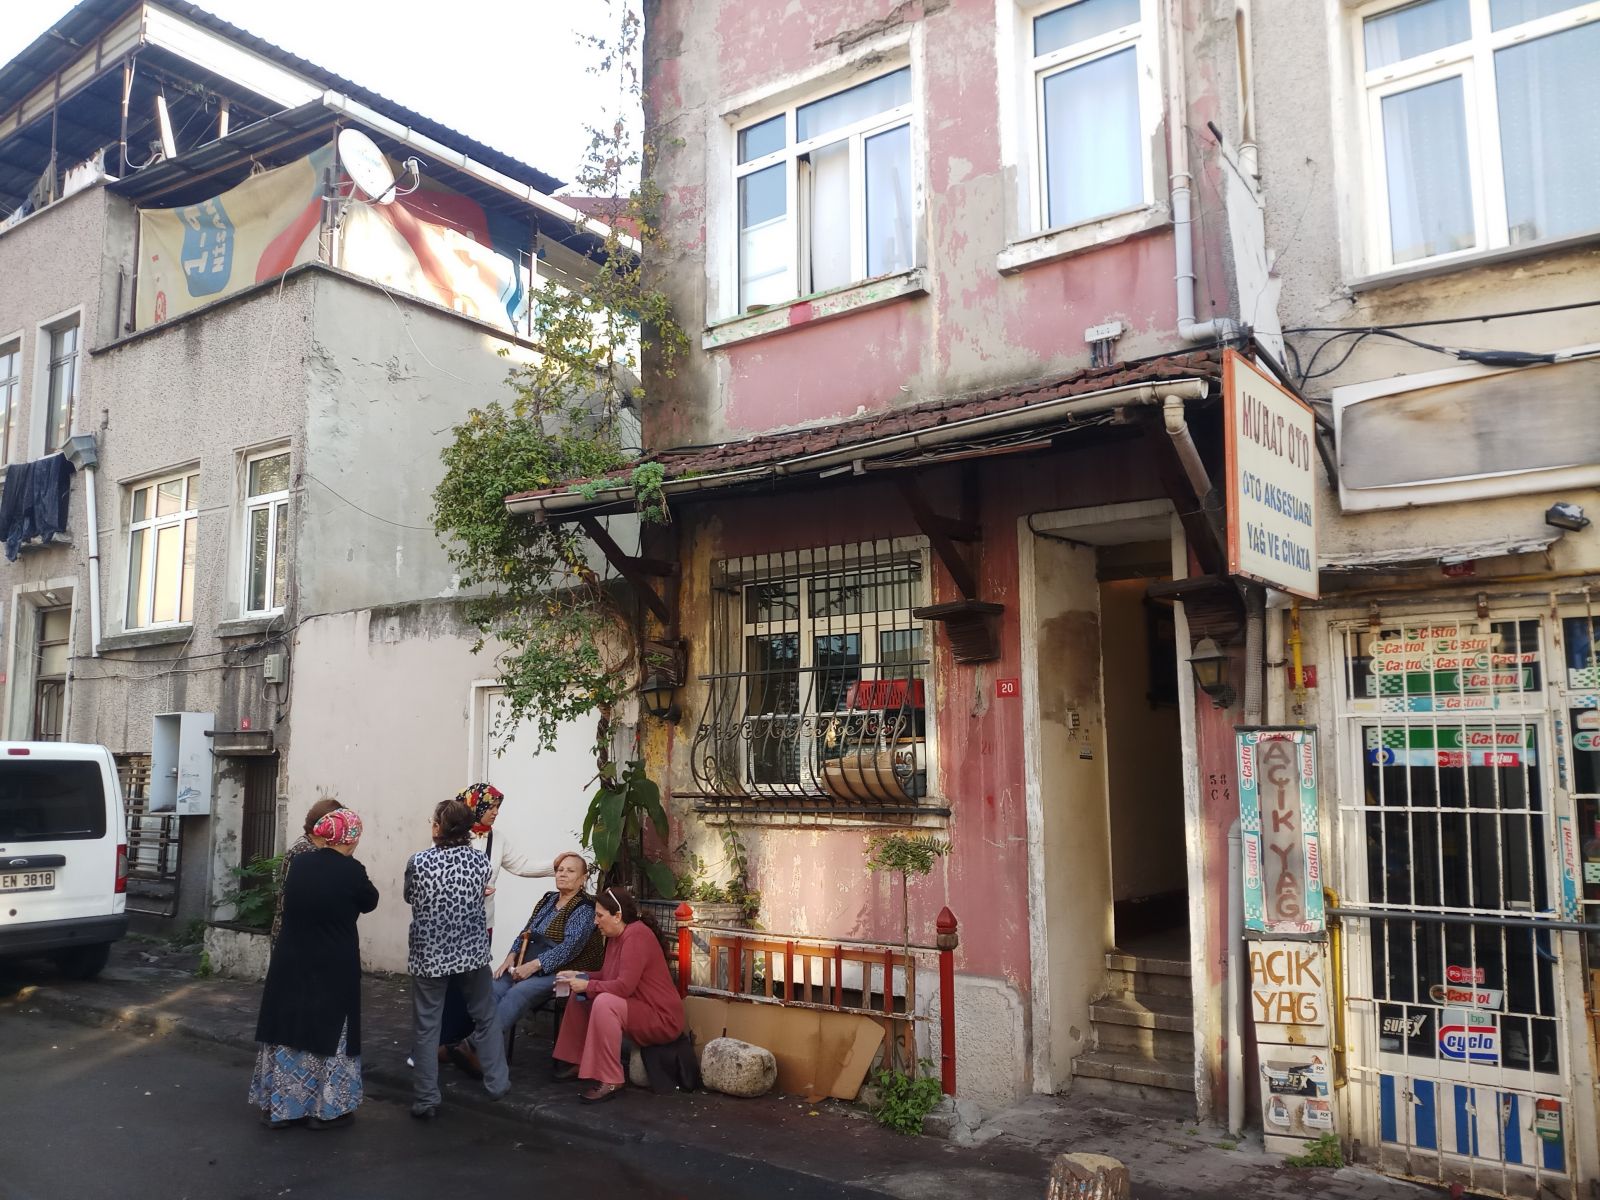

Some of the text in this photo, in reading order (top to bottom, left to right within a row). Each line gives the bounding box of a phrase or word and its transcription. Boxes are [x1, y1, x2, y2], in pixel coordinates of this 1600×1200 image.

[1242, 391, 1309, 471] MURAT OTO
[1242, 470, 1262, 502] OTO
[1267, 531, 1280, 561] VE
[1001, 682, 1014, 693] 20
[1470, 673, 1519, 687] Catrol
[1307, 842, 1318, 879] Castrol
[3, 873, 52, 888] EN 3818
[1447, 988, 1491, 1005] Castol
[1470, 1013, 1485, 1025] bp
[1446, 1033, 1494, 1052] cyclo
